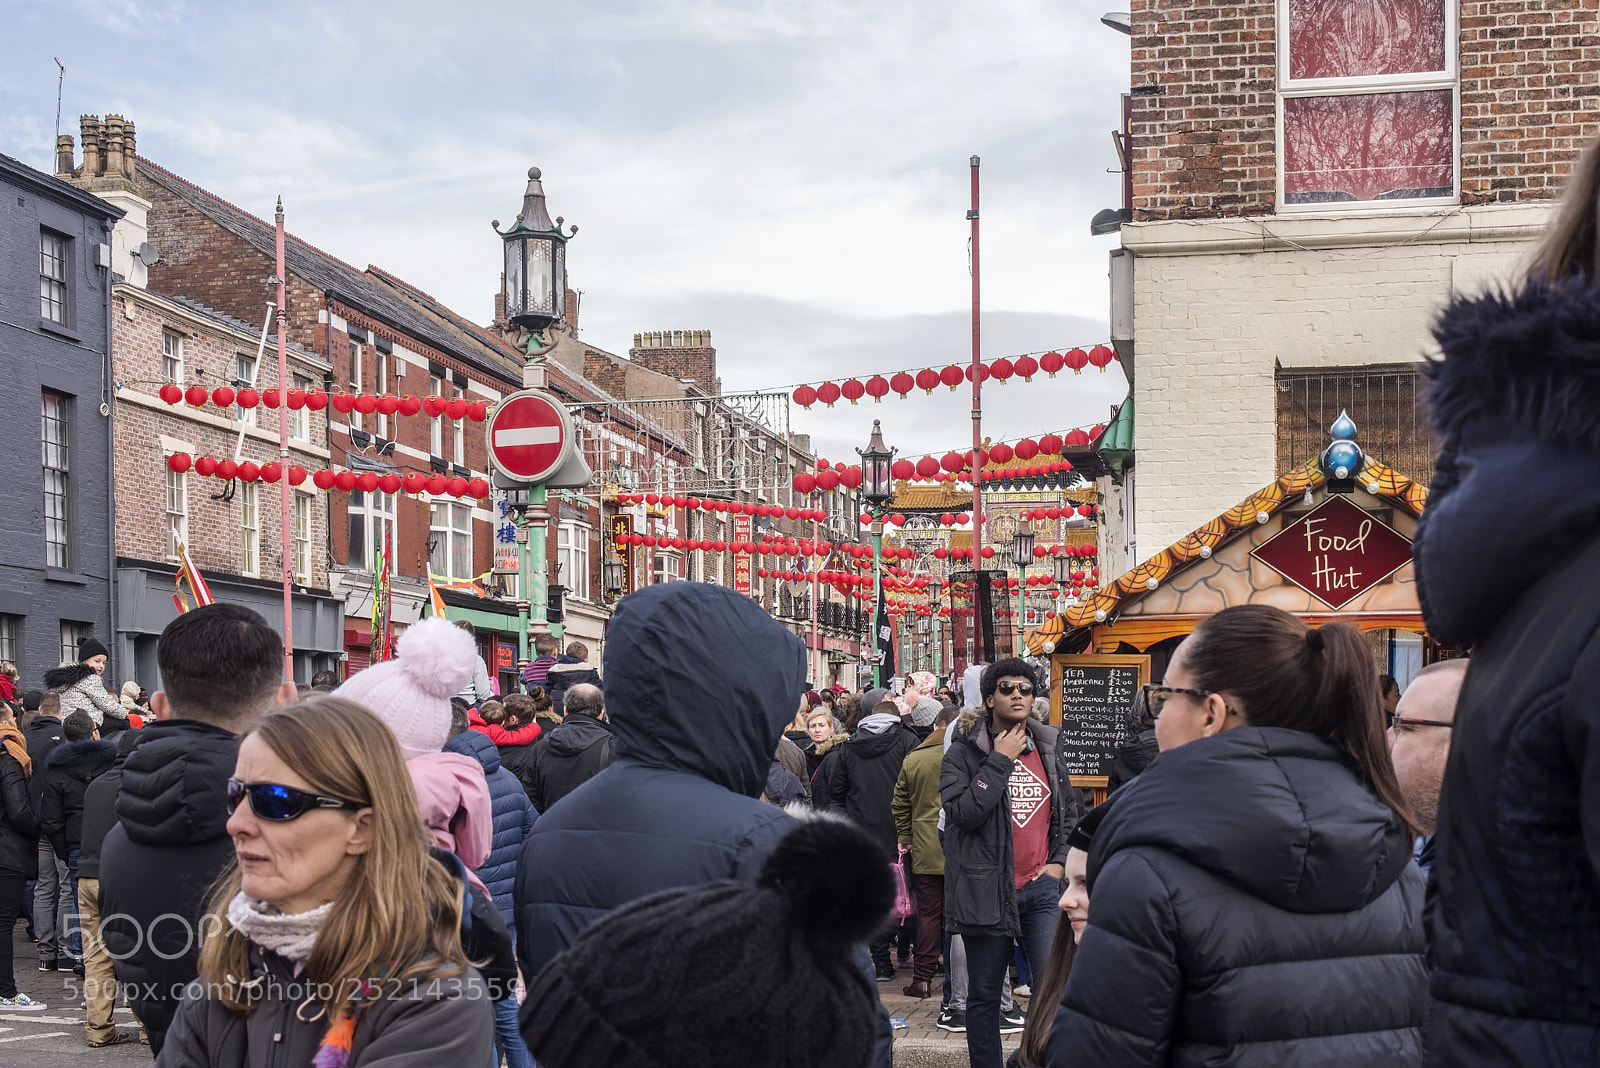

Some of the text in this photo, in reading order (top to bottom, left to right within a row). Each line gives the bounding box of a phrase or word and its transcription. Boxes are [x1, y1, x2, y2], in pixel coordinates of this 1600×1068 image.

[1303, 517, 1372, 555] Food
[1311, 554, 1363, 592] Hut
[1064, 668, 1085, 678] TEA
[1063, 678, 1105, 686] AMERICANO
[1010, 785, 1042, 798] OTOR
